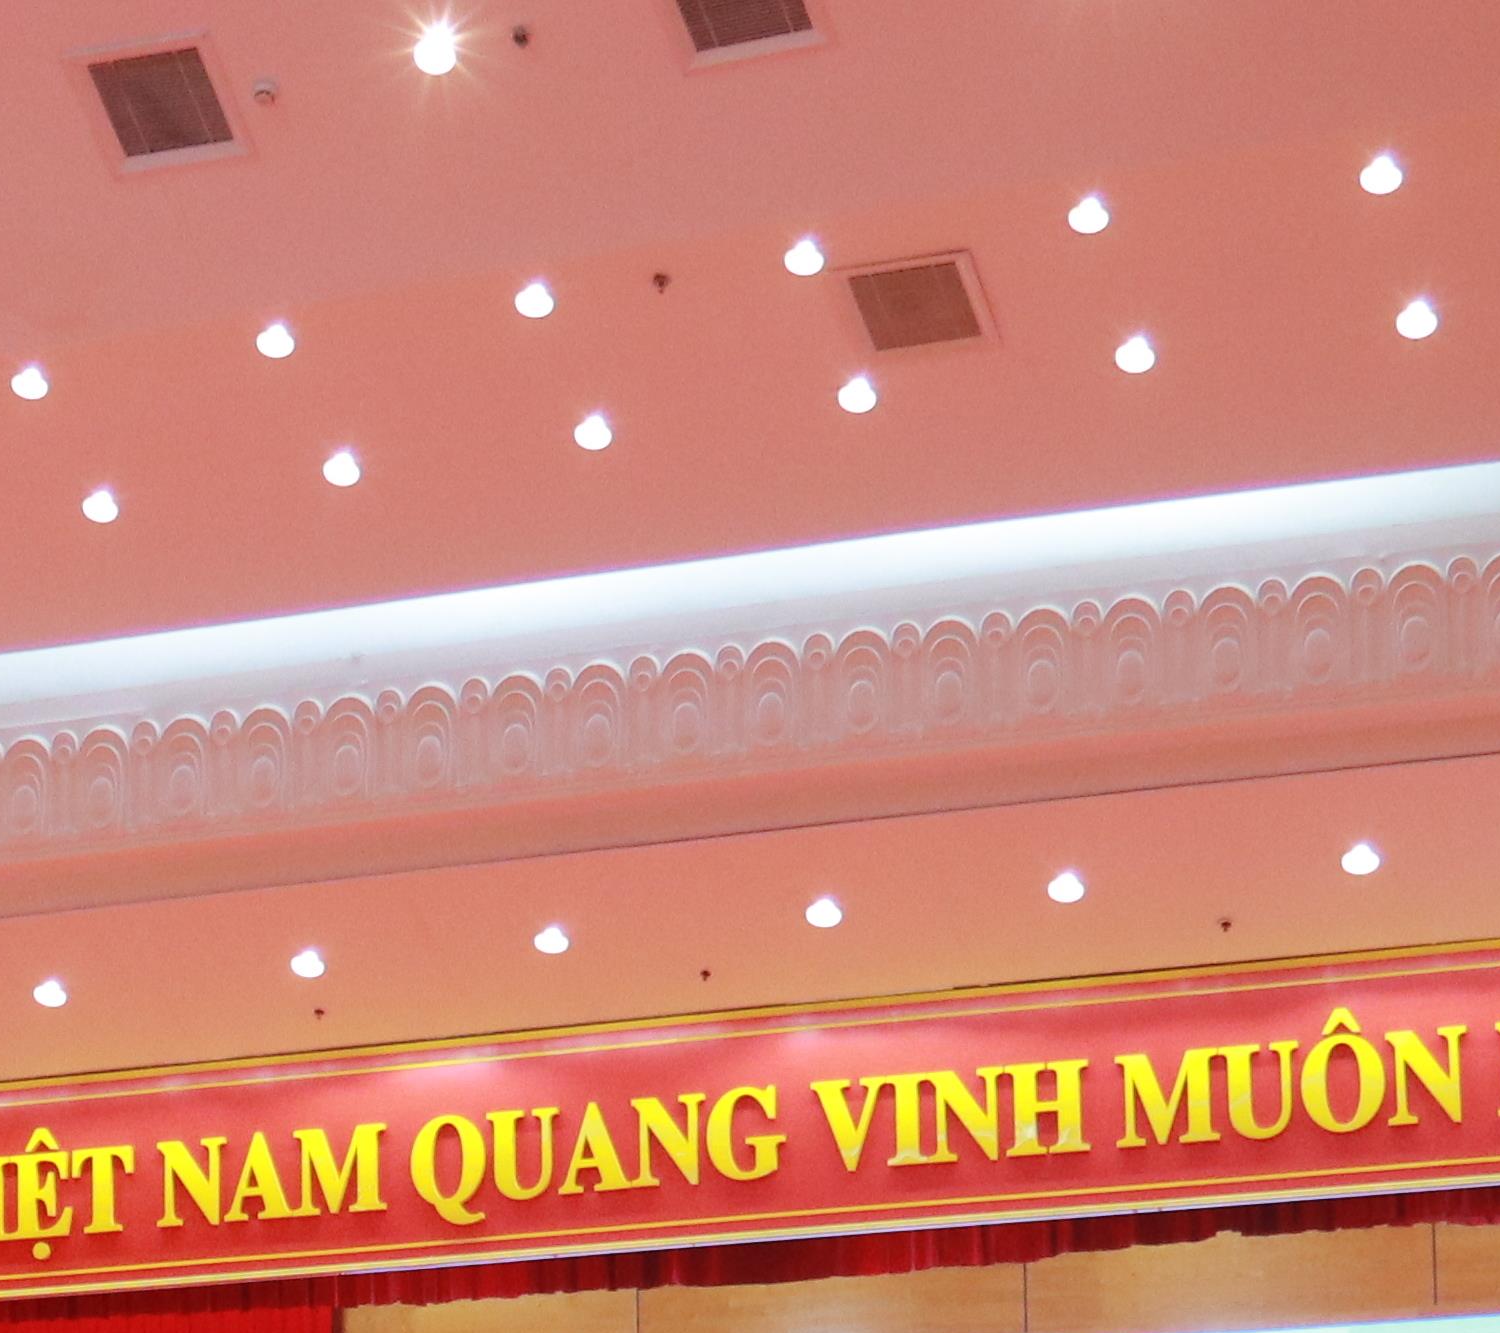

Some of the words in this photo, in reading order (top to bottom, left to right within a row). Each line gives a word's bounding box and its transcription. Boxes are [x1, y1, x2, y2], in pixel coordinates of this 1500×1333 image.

[156, 1122, 388, 1226] NAM
[411, 1085, 786, 1224] QUANG
[809, 1059, 1090, 1170] VINH
[1115, 1007, 1468, 1147] MUÔN
